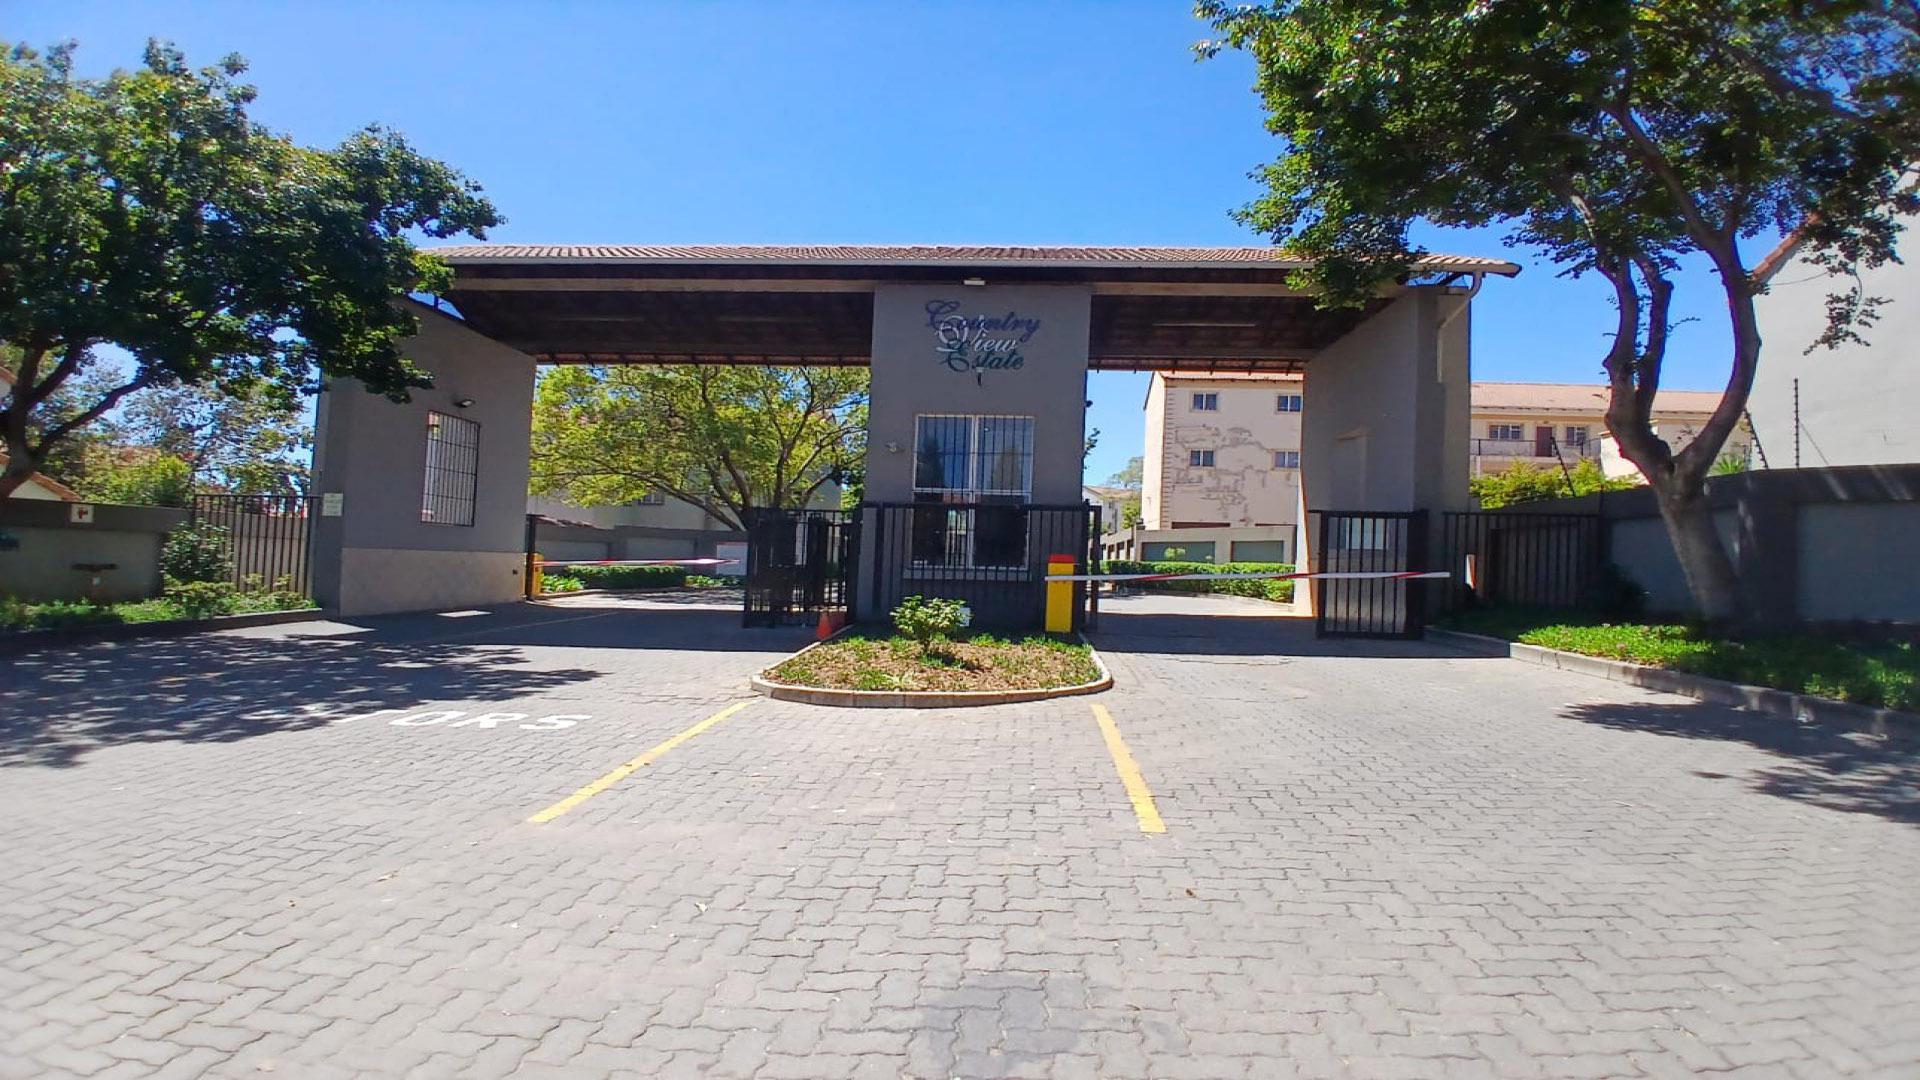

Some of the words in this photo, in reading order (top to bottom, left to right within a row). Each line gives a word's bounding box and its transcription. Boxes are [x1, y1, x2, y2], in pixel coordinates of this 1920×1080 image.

[925, 300, 1041, 343] Country
[935, 314, 1018, 352] View
[940, 340, 1025, 373] Estate
